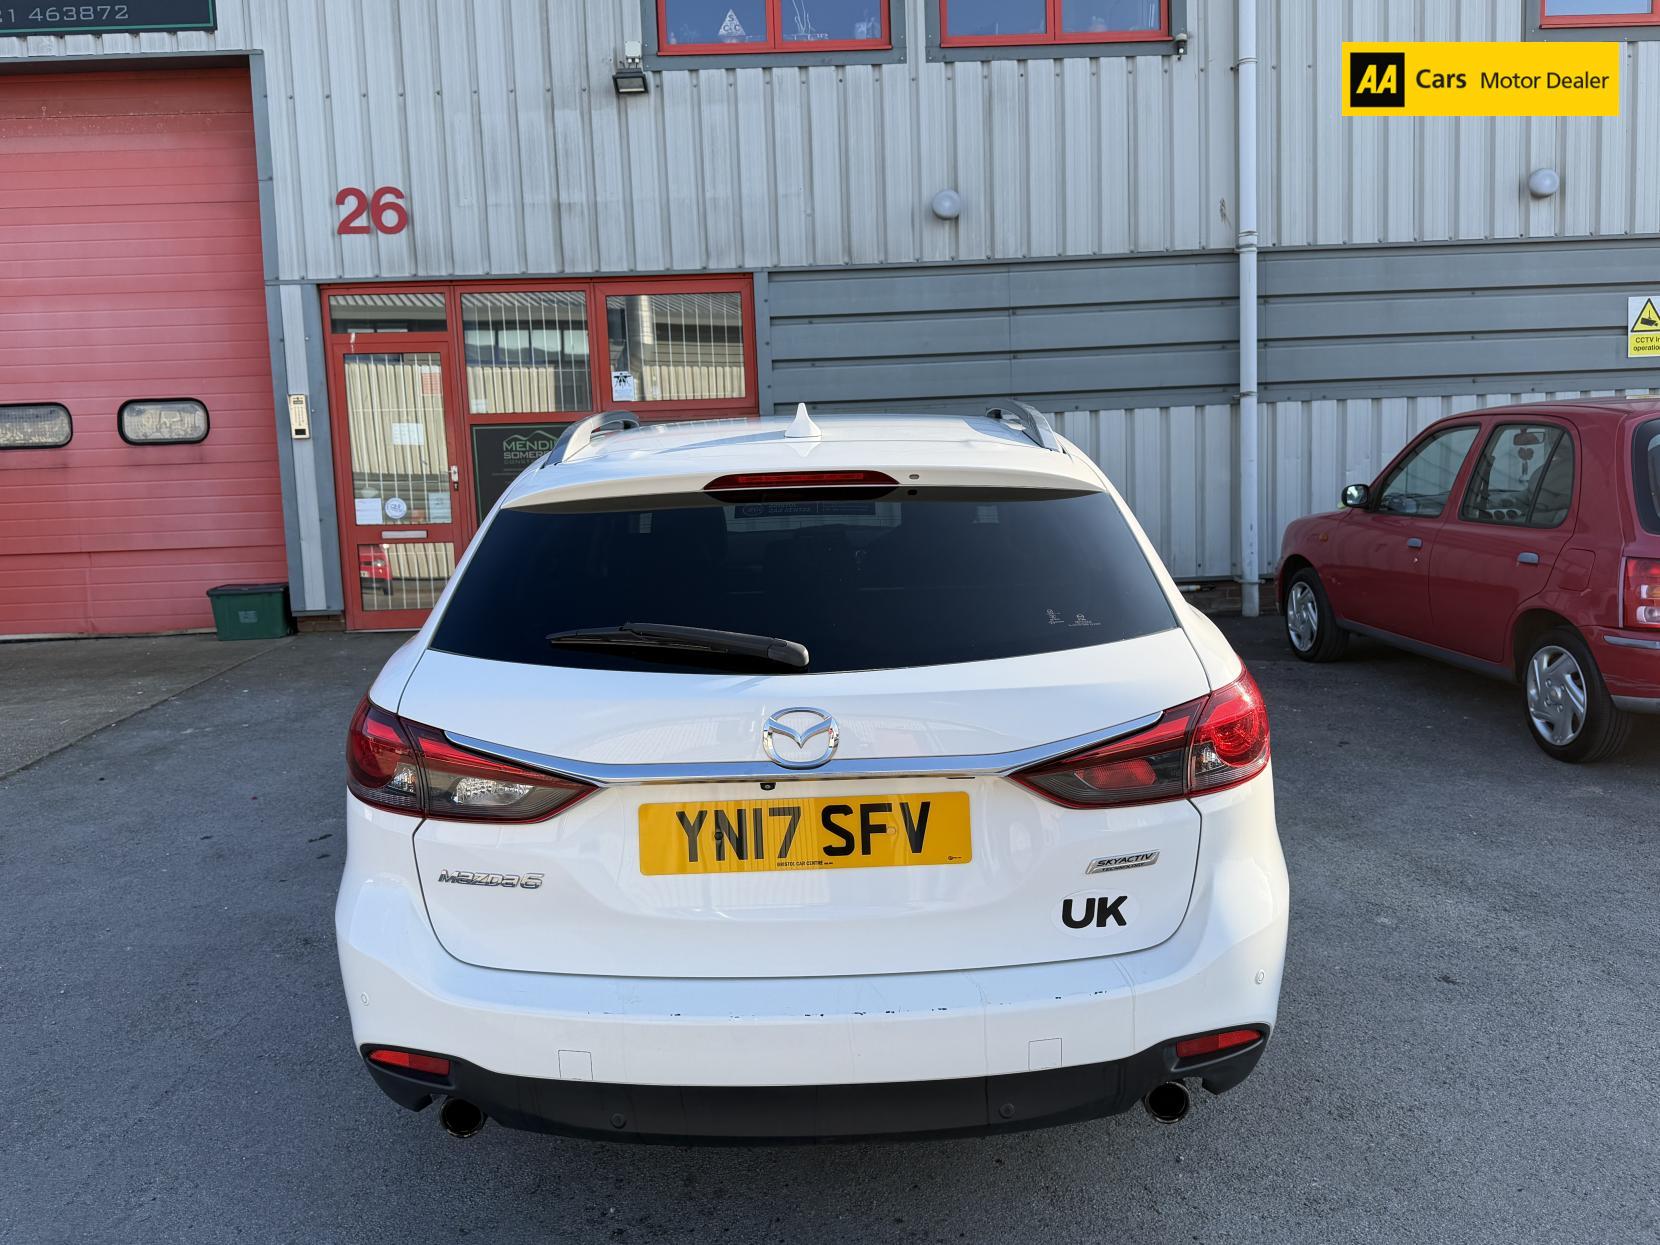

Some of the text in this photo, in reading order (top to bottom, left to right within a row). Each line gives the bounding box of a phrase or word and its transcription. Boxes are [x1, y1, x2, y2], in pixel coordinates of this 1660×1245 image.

[0, 5, 129, 23] 1 463872
[335, 186, 408, 235] 26
[503, 440, 556, 451] MENDI
[675, 801, 931, 862] YN17 SFV
[1096, 852, 1154, 867] SKYACTIV
[1061, 895, 1128, 929] UK
